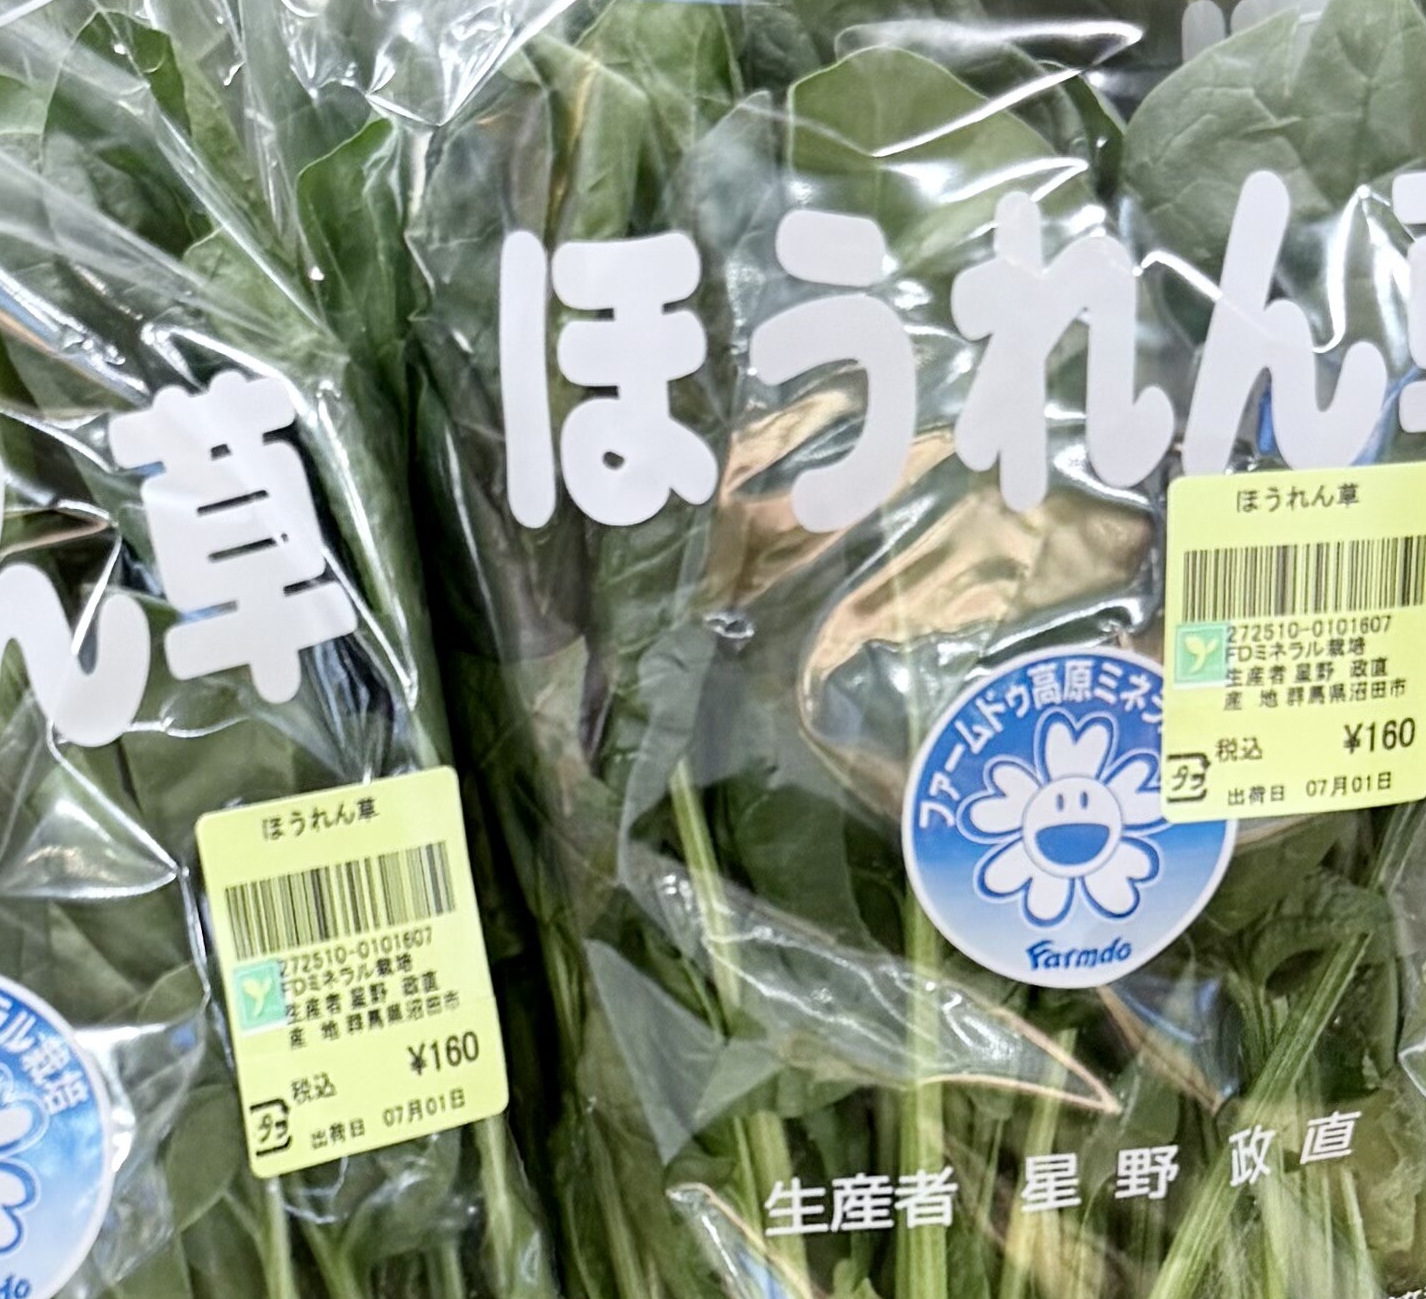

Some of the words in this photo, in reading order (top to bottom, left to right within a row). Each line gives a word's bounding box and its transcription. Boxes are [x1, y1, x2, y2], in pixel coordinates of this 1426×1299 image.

[1235, 483, 1361, 514] ほうれん草
[1226, 615, 1392, 644] 272510-0101607
[1215, 737, 1263, 763] 税込
[1343, 717, 1416, 754] ¥160
[1227, 785, 1286, 807] 出荷日
[1305, 771, 1392, 798] 07月01日
[261, 798, 379, 842] ほうれん草
[1026, 937, 1132, 972] Farmdo
[407, 1031, 480, 1075] ¥160
[291, 1072, 338, 1103] 税込
[382, 1087, 466, 1127] 07月01日
[764, 1165, 958, 1238] 生産者
